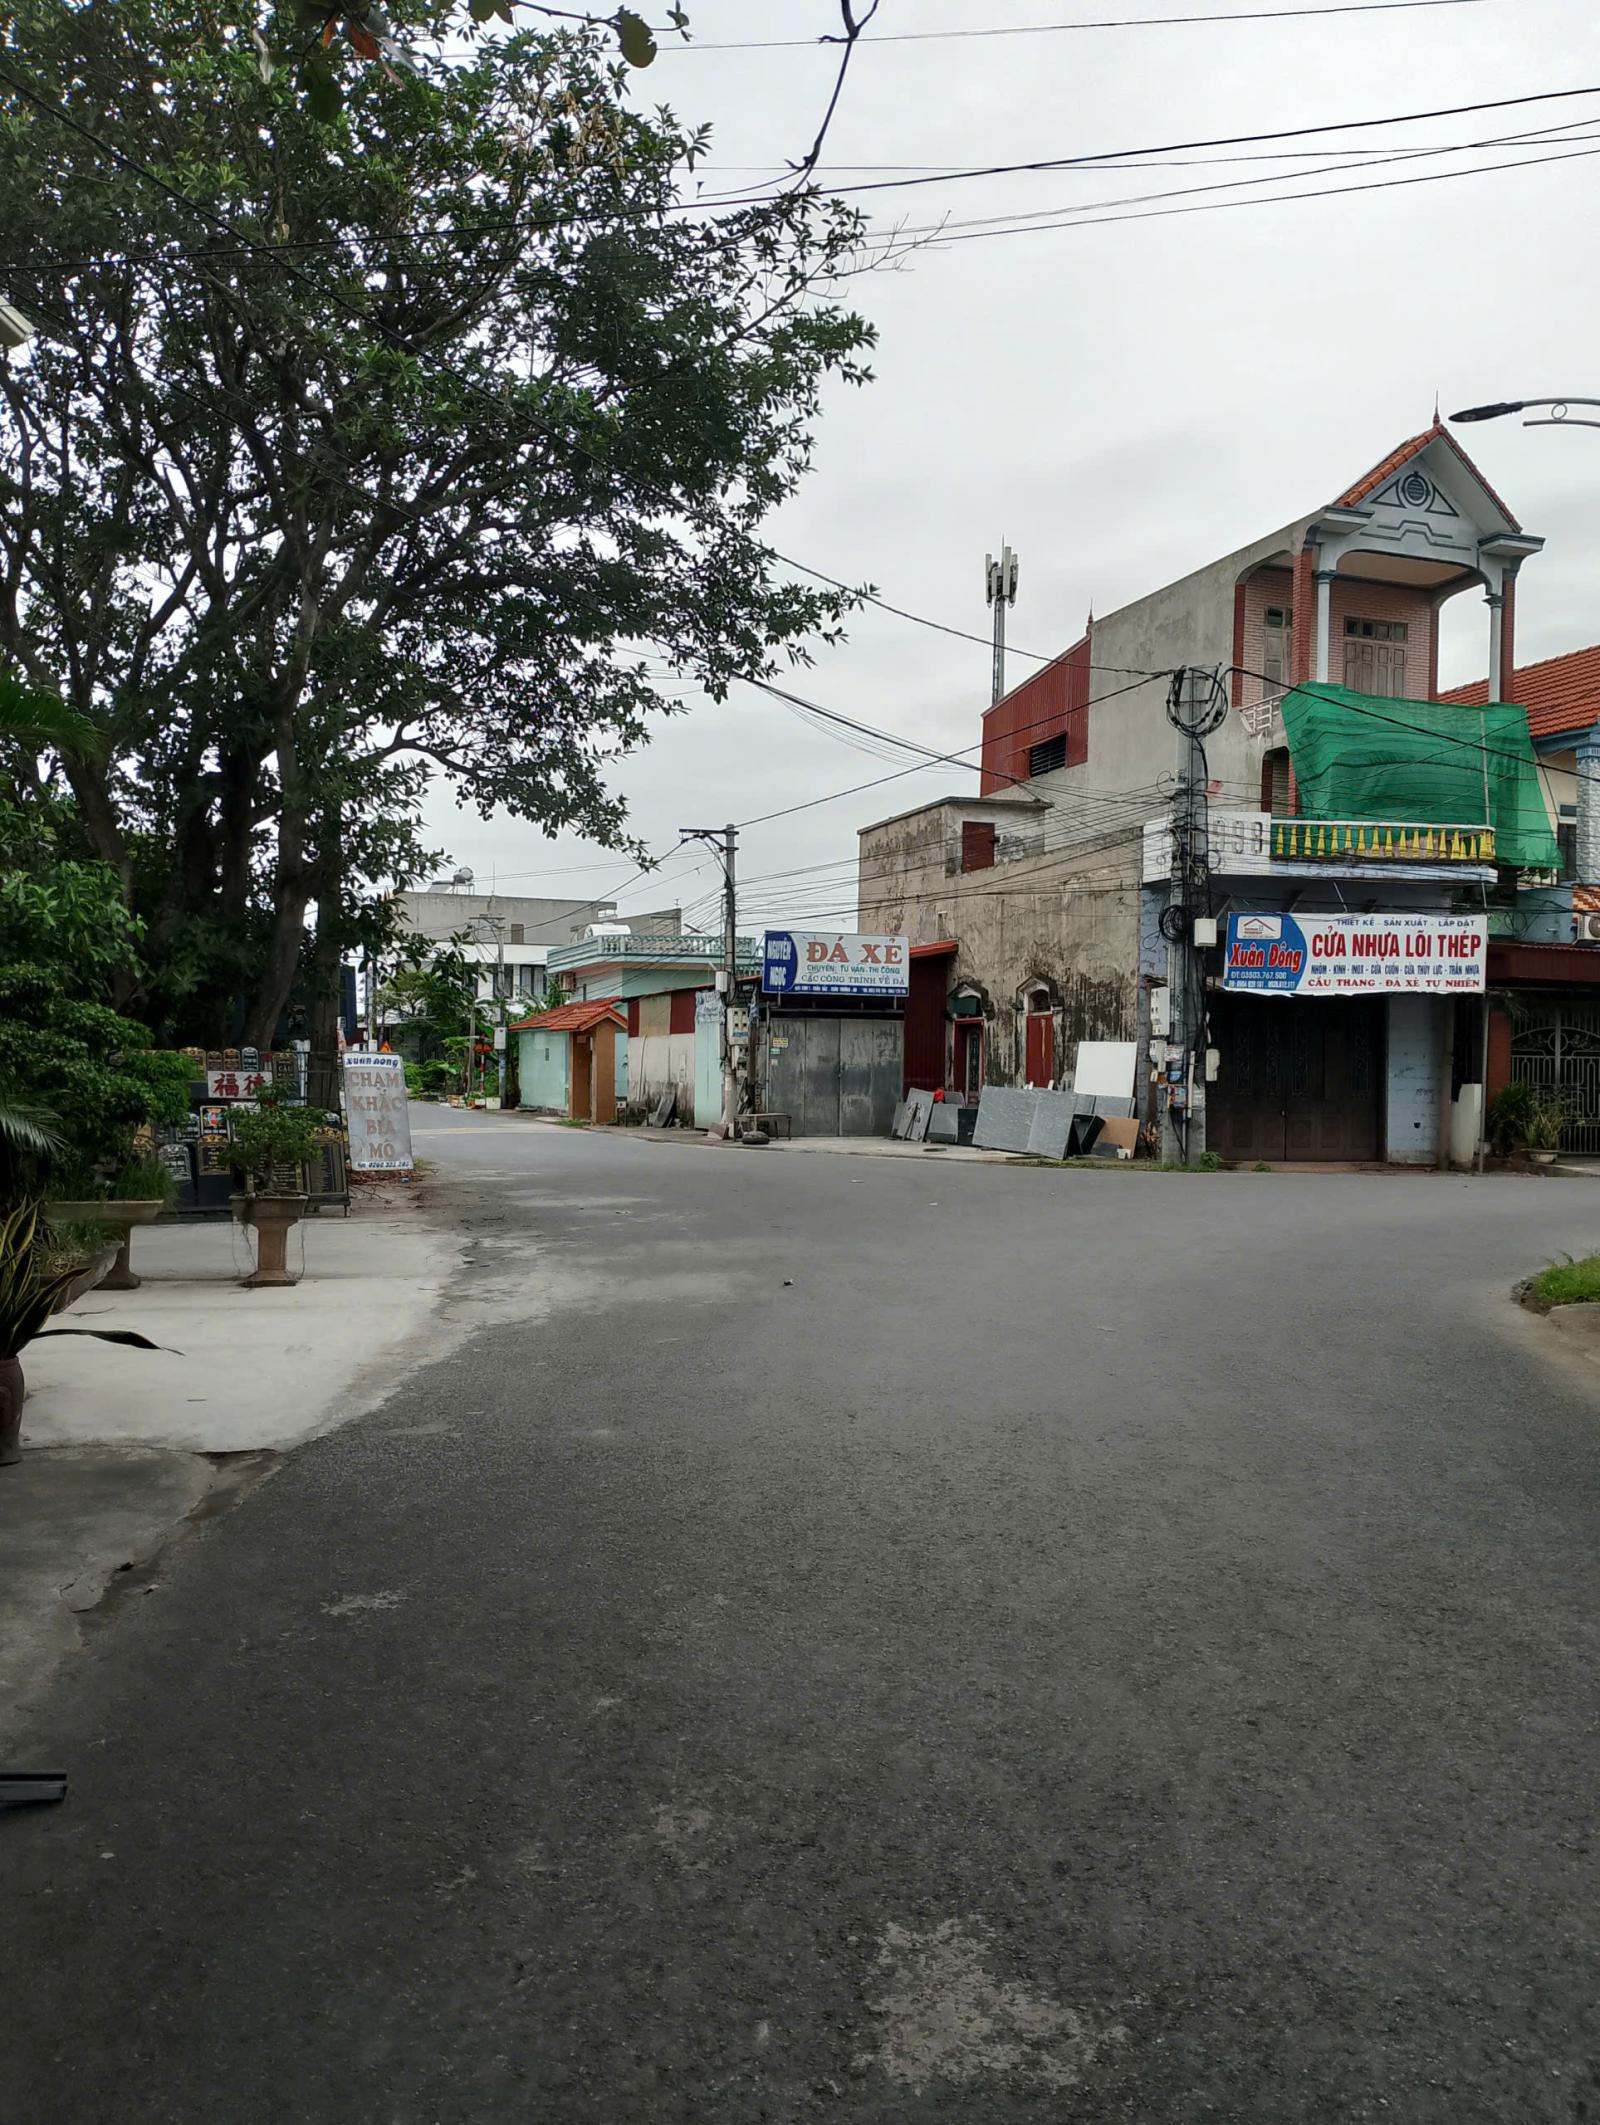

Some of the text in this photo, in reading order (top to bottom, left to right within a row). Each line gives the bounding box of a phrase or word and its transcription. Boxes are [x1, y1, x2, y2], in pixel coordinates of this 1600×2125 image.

[806, 936, 903, 965] ĐÁ XẺ
[1228, 941, 1265, 968] Xuân
[1312, 925, 1482, 962] CỬA NHỰA LÕI THÉP
[820, 974, 845, 984] CÔNG
[1336, 979, 1376, 987] THANG
[347, 1071, 400, 1091] CHẠM
